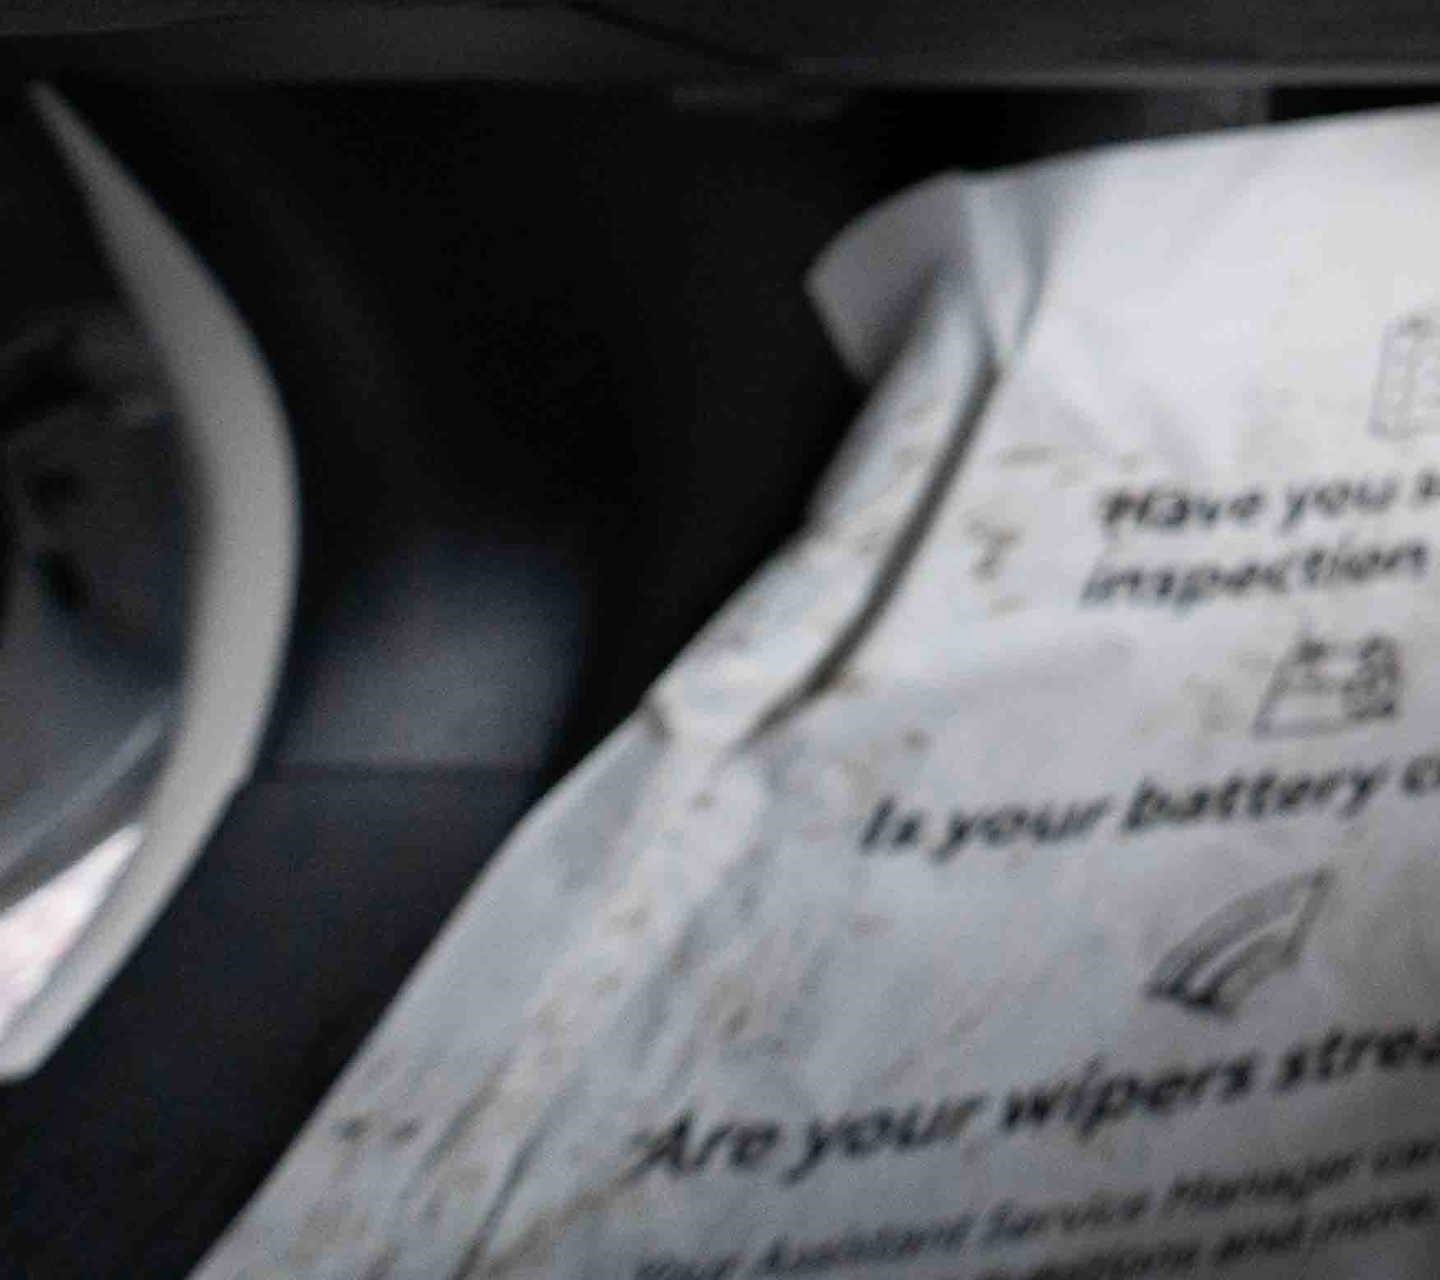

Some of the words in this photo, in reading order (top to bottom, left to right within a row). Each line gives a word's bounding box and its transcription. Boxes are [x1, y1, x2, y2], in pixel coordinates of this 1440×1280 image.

[1101, 482, 1265, 531] Have
[1281, 476, 1399, 531] you
[1079, 545, 1426, 616] inspection
[860, 796, 919, 855] Is
[930, 796, 1114, 862] your
[1122, 763, 1389, 835] battery
[634, 1112, 780, 1182] Are
[791, 1090, 987, 1185] your
[1004, 1047, 1255, 1138] wipers
